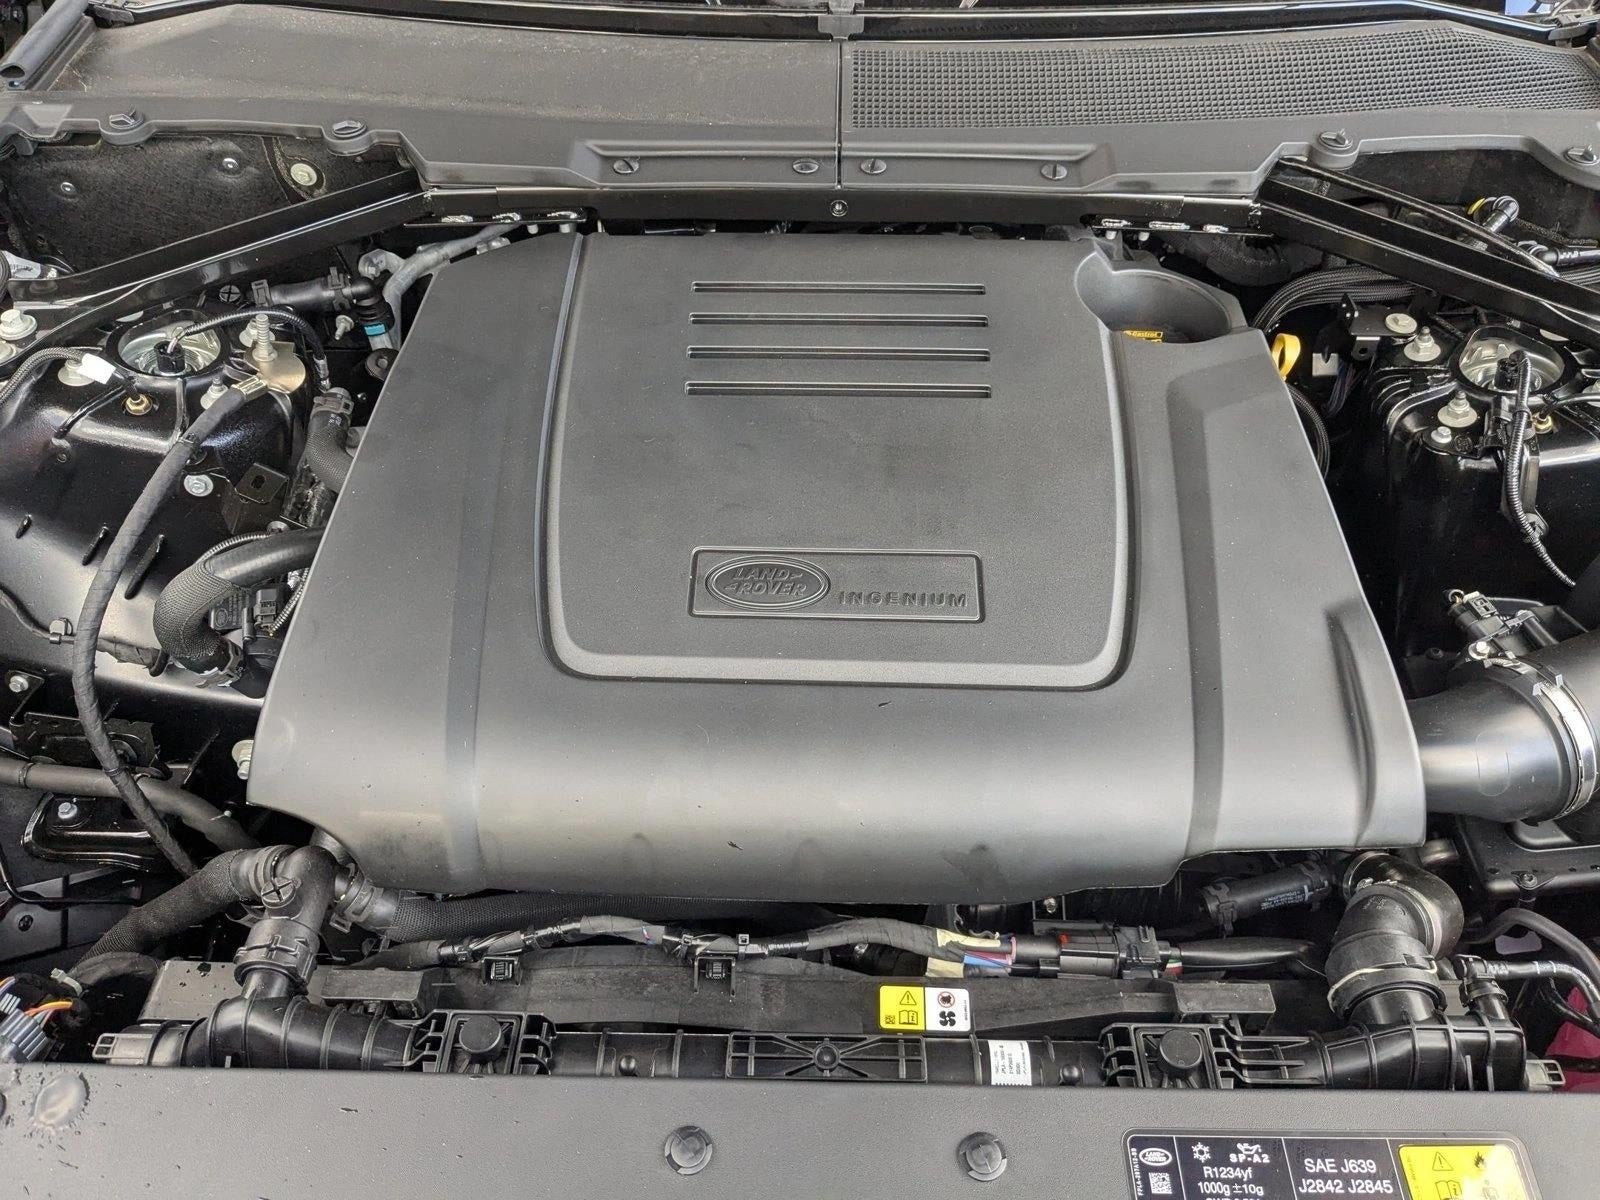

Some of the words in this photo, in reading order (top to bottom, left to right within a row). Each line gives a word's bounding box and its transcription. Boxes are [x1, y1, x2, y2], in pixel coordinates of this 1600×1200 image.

[839, 591, 968, 607] INGENIUM
[1229, 1153, 1271, 1163] SP-A2
[1304, 1158, 1338, 1173] SAE
[1340, 1159, 1377, 1173] J639
[1203, 1166, 1253, 1181] R1234yf
[1197, 1181, 1231, 1196] 1000g
[1299, 1178, 1345, 1193] J2842
[1347, 1179, 1394, 1194] J2845
